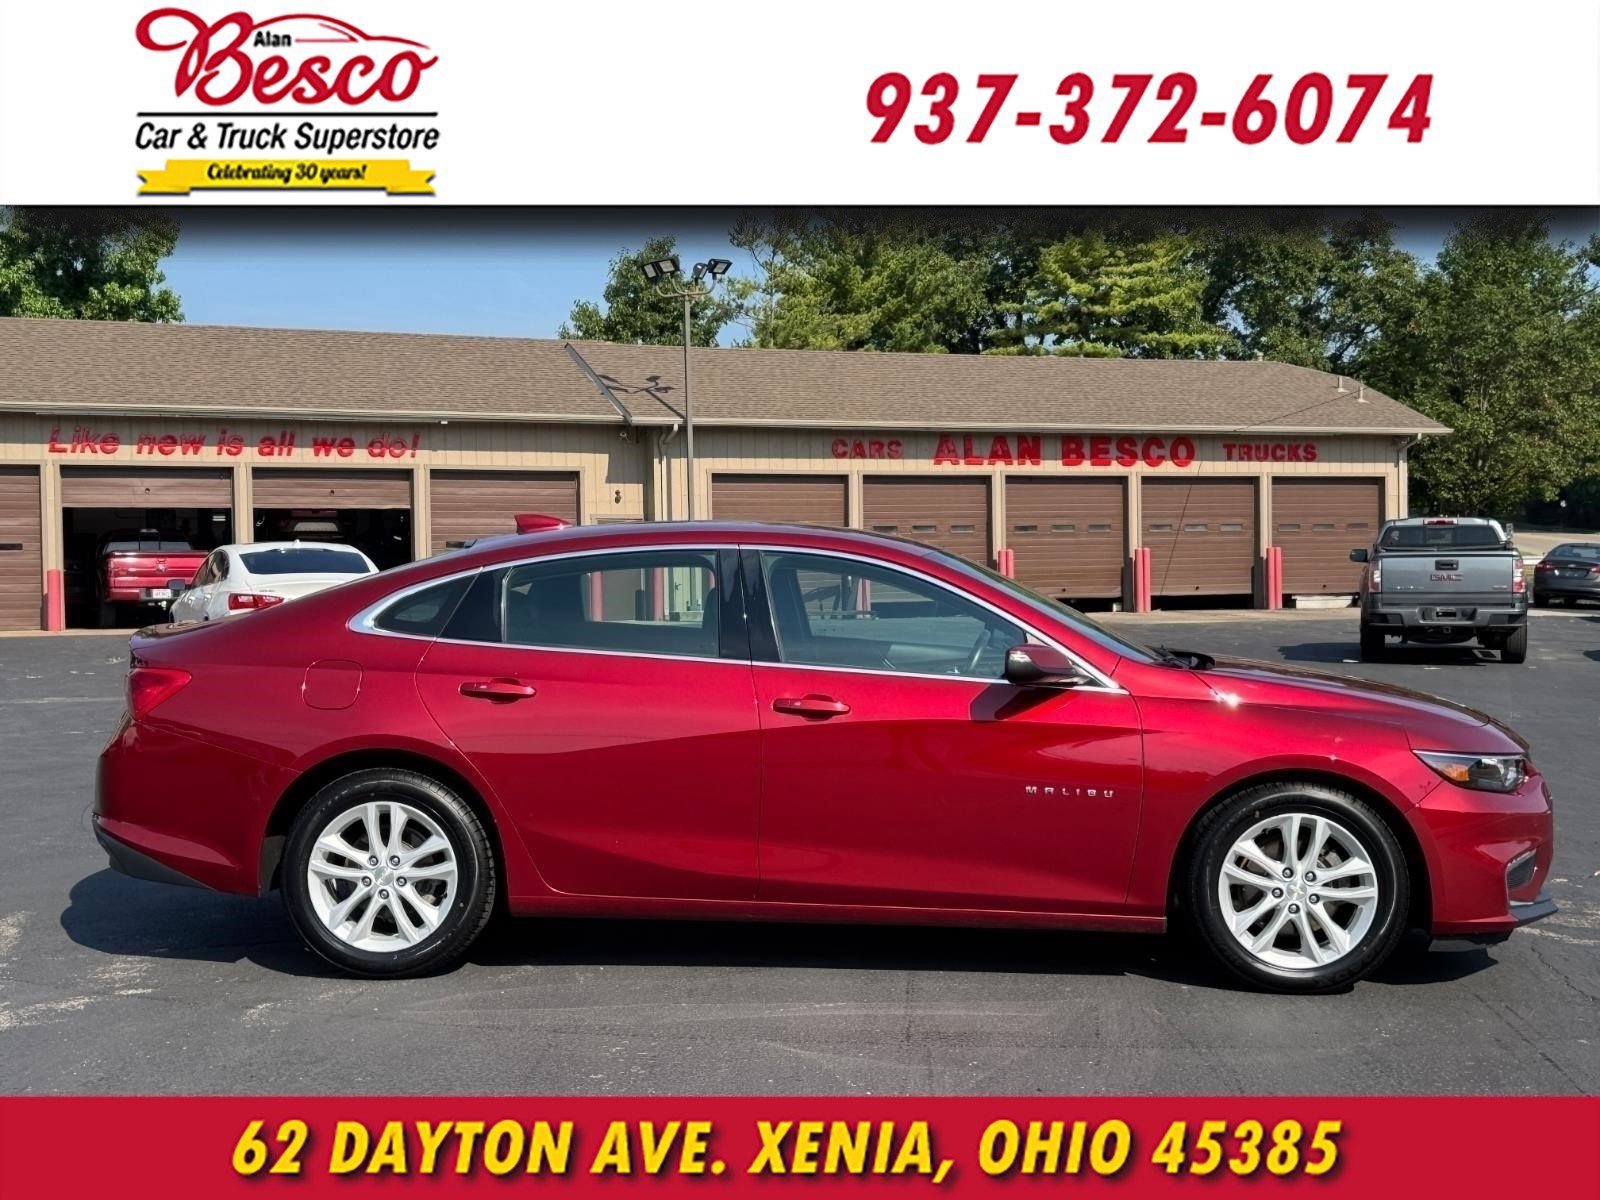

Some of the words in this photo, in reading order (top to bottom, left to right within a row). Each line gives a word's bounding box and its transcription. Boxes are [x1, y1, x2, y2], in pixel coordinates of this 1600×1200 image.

[48, 425, 121, 455] Like
[136, 432, 206, 456] new
[216, 428, 245, 457] is
[257, 430, 296, 457] all
[312, 436, 356, 458] we
[367, 431, 421, 459] do!
[831, 438, 903, 459] CARS
[932, 434, 1043, 467] ALAN
[1060, 436, 1196, 469] BESCO
[1222, 442, 1318, 463] TRUCKS
[1025, 785, 1114, 798] MALIBU
